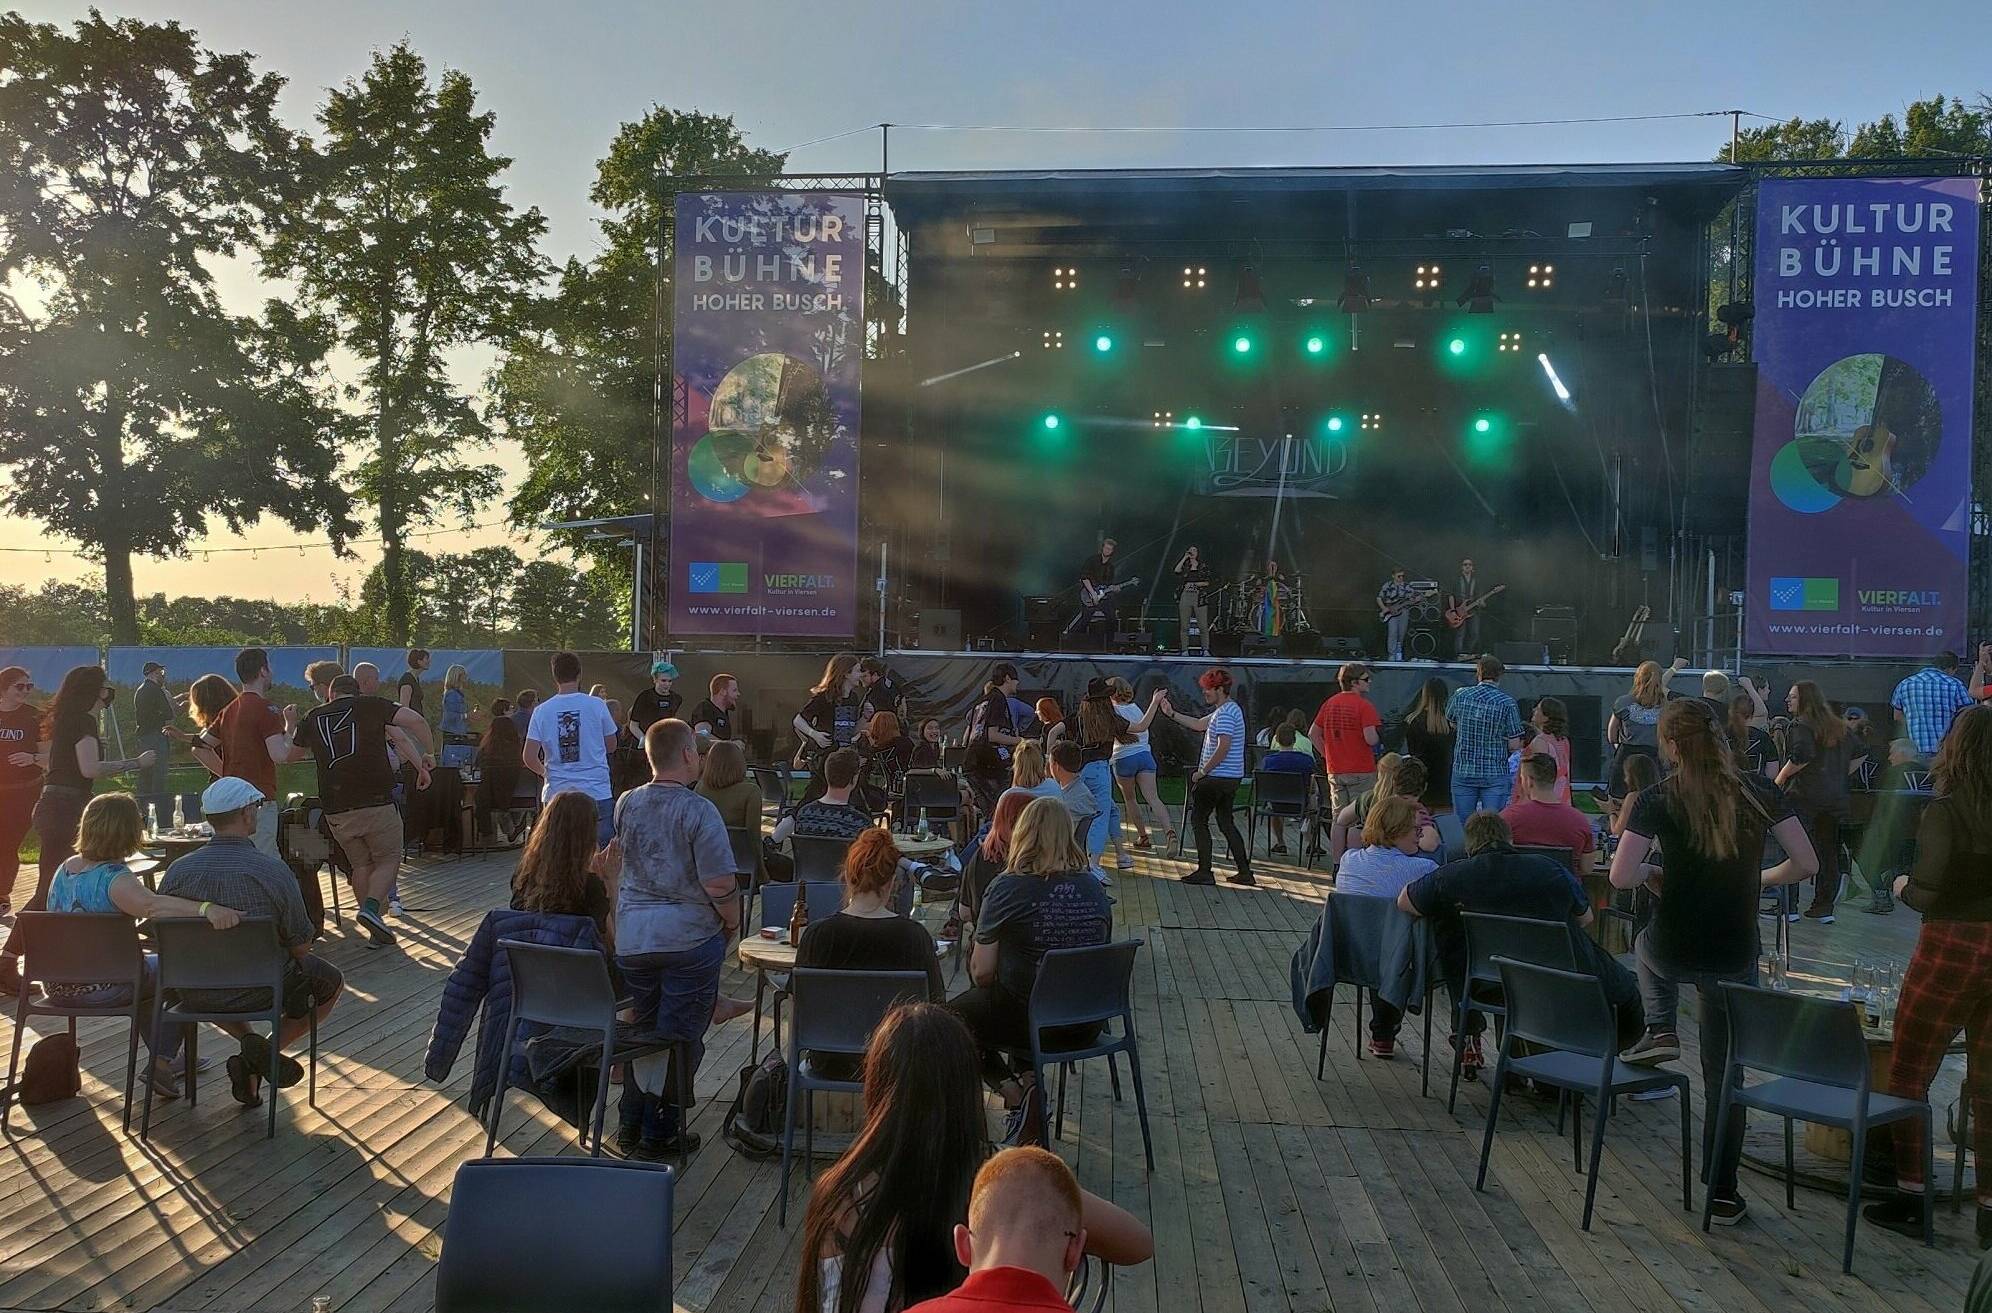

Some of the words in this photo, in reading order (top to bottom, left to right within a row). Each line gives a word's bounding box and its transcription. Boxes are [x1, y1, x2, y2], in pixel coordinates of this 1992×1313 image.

[694, 215, 843, 243] KULTUR
[1781, 203, 1954, 235] KULTUR
[693, 247, 842, 283] BÜHNE
[1779, 238, 1953, 277] BÜHNE
[693, 293, 765, 311] HOHER
[773, 293, 842, 311] BUSCH
[1777, 290, 1862, 308] HOHER
[1871, 288, 1952, 308] BUSCH
[688, 605, 836, 617] www.vierfalt-viersen.de
[1769, 623, 1943, 637] www.vierfalt-viersen.de
